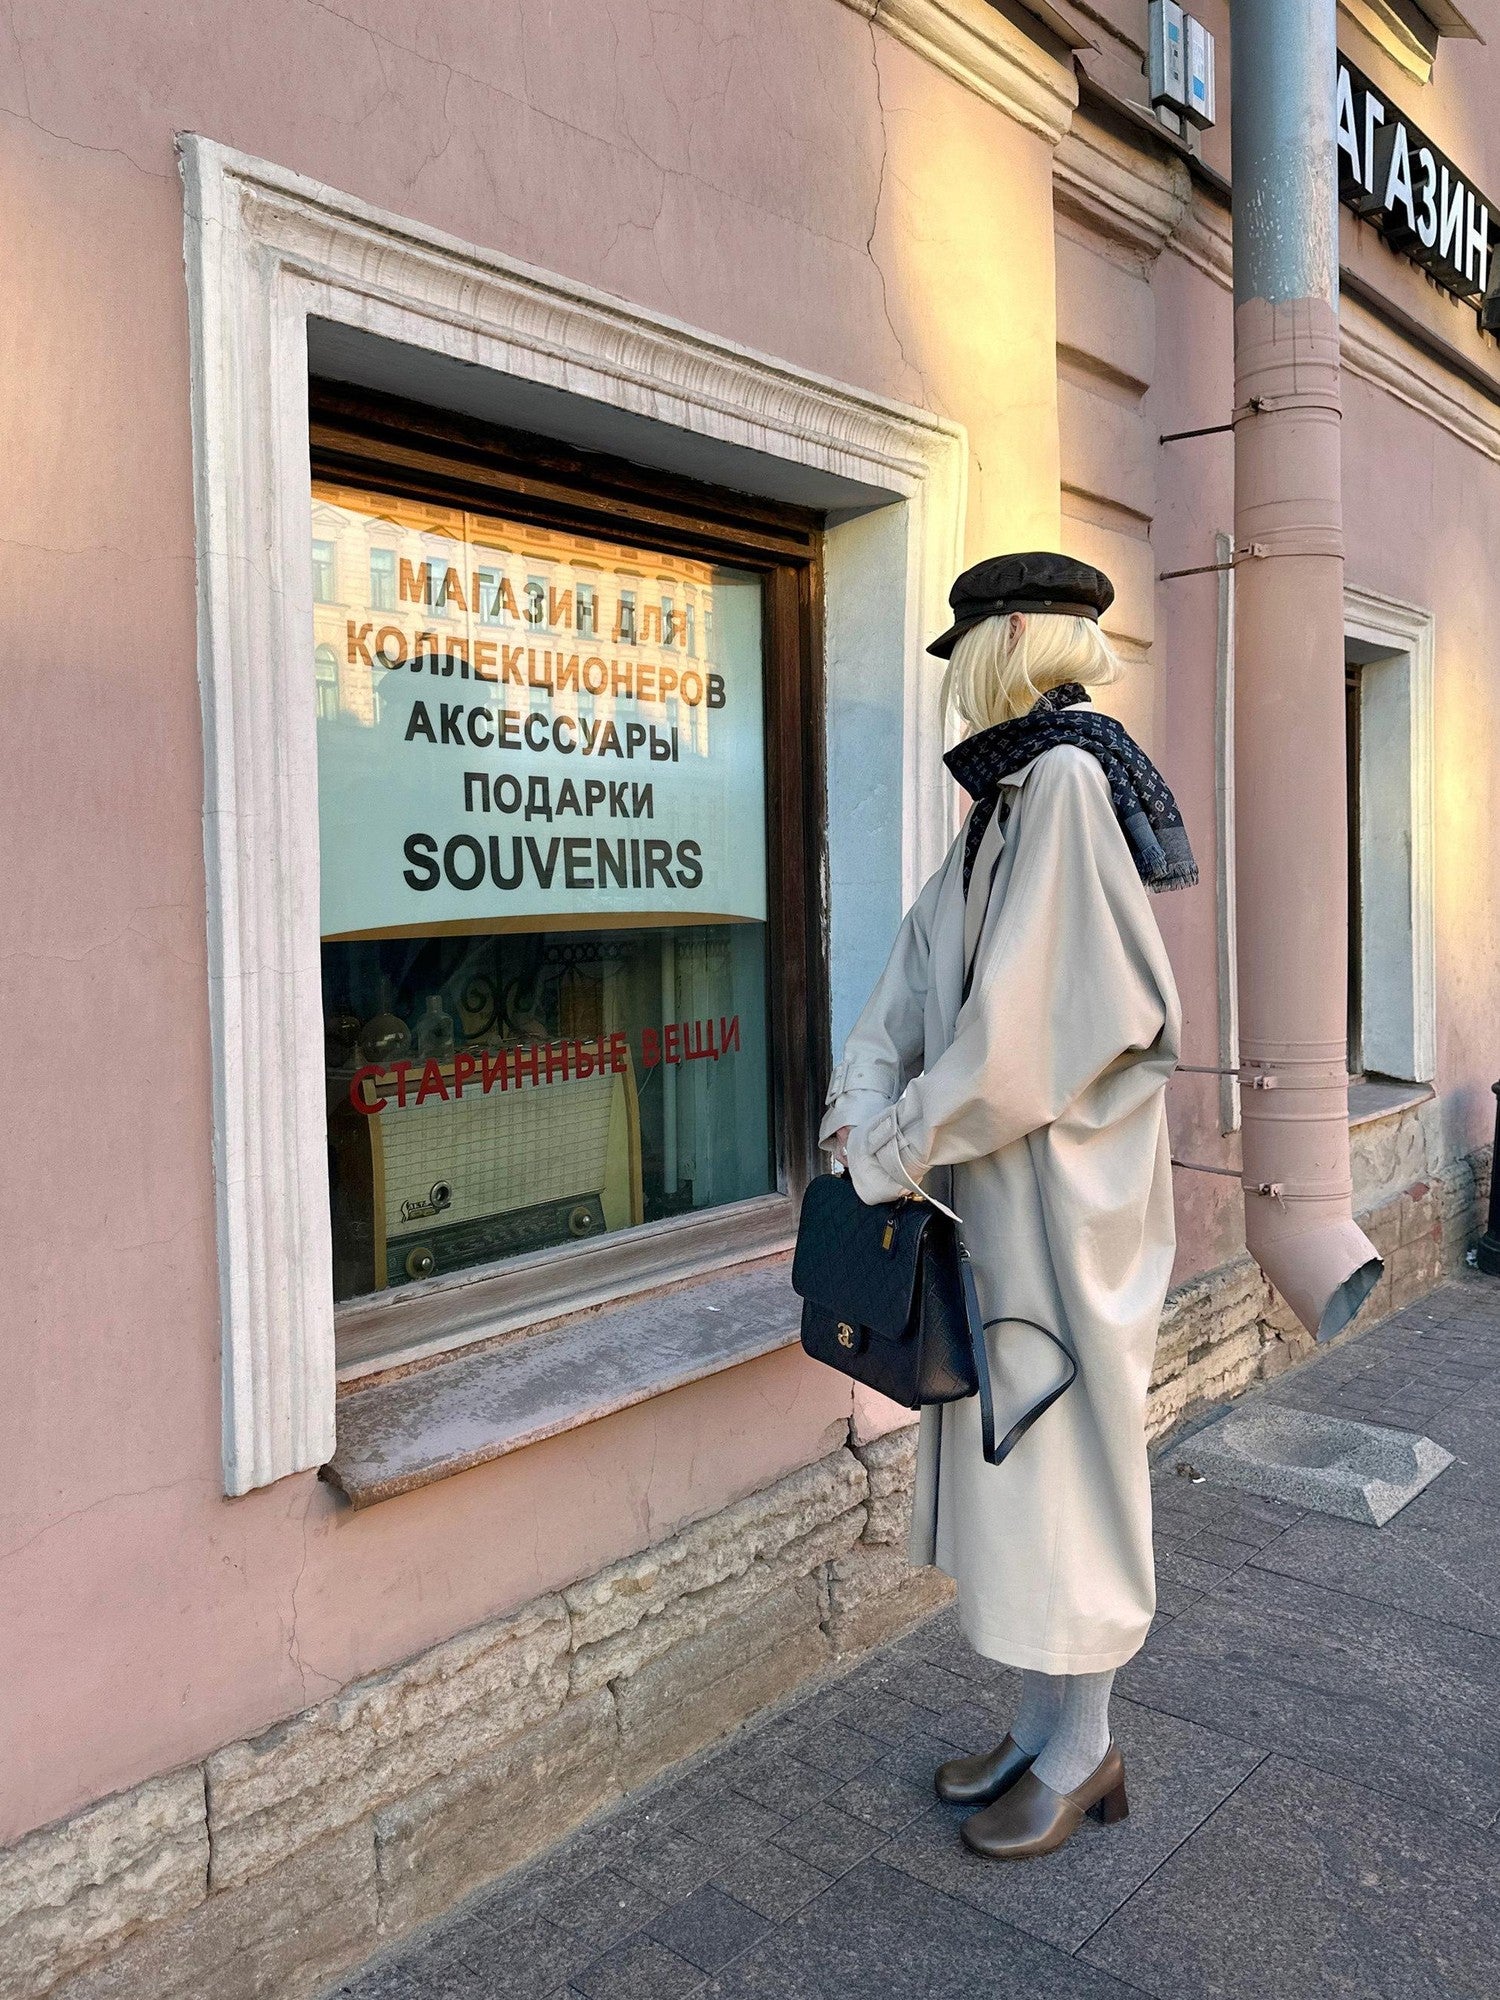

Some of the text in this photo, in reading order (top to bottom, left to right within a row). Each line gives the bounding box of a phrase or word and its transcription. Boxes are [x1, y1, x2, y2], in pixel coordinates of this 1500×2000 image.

[1337, 65, 1488, 293] АГАЗИН
[399, 557, 687, 647] МАГАЗИН ДЛЯ
[346, 620, 727, 709] КОЛЛЕКЦИОНЕРОВ
[404, 700, 680, 763] АКСЕССУАРЫ
[463, 772, 654, 823] ПОДАРКИ
[402, 833, 704, 891] SOUVENIRS
[350, 1015, 741, 1115] СТАРИННЫЕ ВЕЩИ
